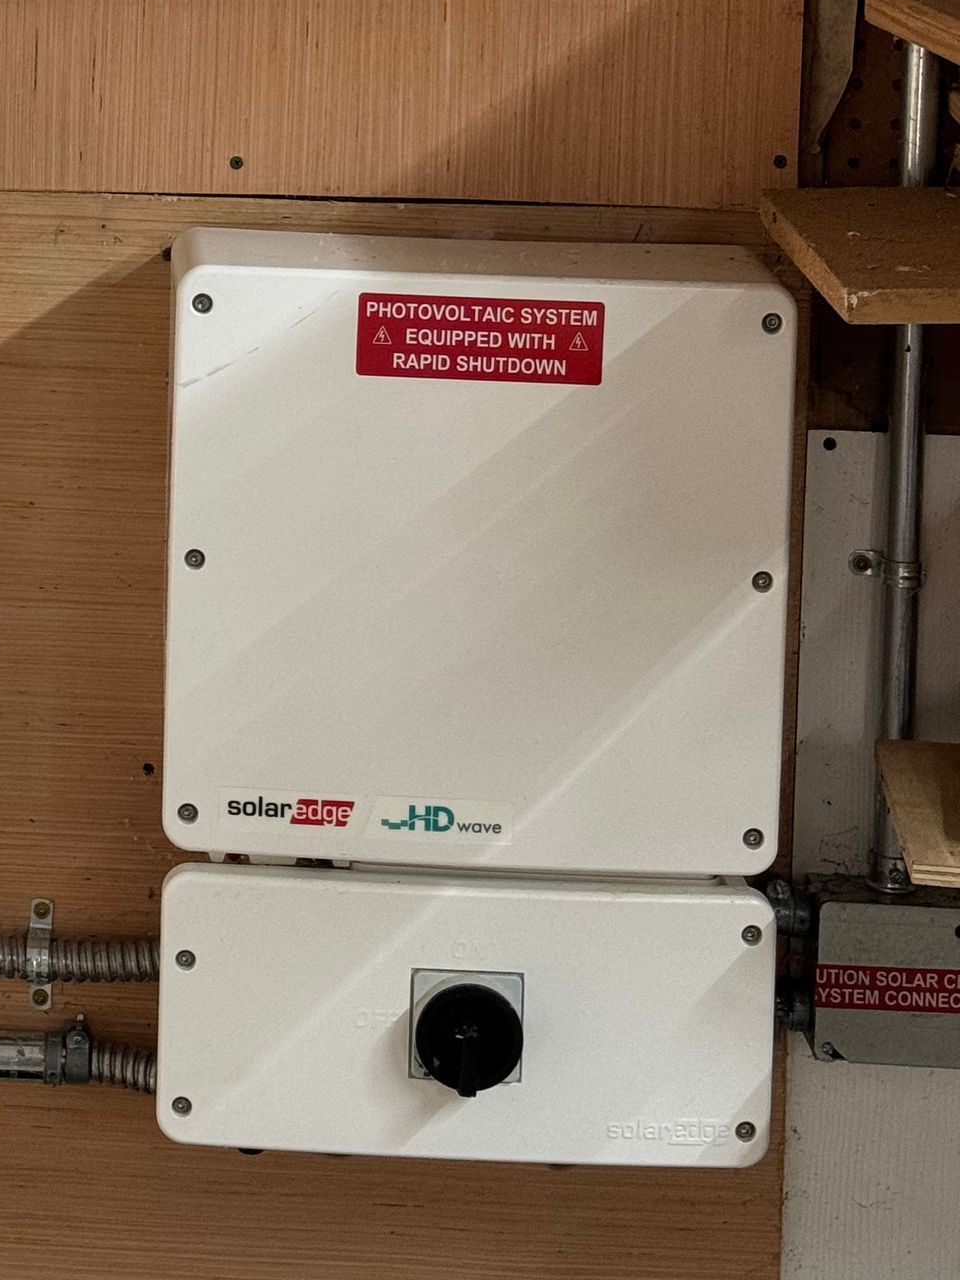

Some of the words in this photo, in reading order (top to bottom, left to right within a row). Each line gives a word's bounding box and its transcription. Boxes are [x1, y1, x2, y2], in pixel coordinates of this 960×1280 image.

[366, 301, 515, 323] PHOTOVOLTAIC
[520, 307, 598, 326] SYSTEM
[405, 328, 502, 348] EQUIPPED
[508, 332, 556, 350] WITH
[392, 352, 450, 371] RAPID
[456, 355, 567, 376] SHUTDOWN
[227, 796, 353, 827] solaredge
[408, 804, 455, 832] HD
[456, 820, 502, 834] wave
[876, 971, 939, 989] SOLAR
[885, 991, 960, 1009] CONNEC
